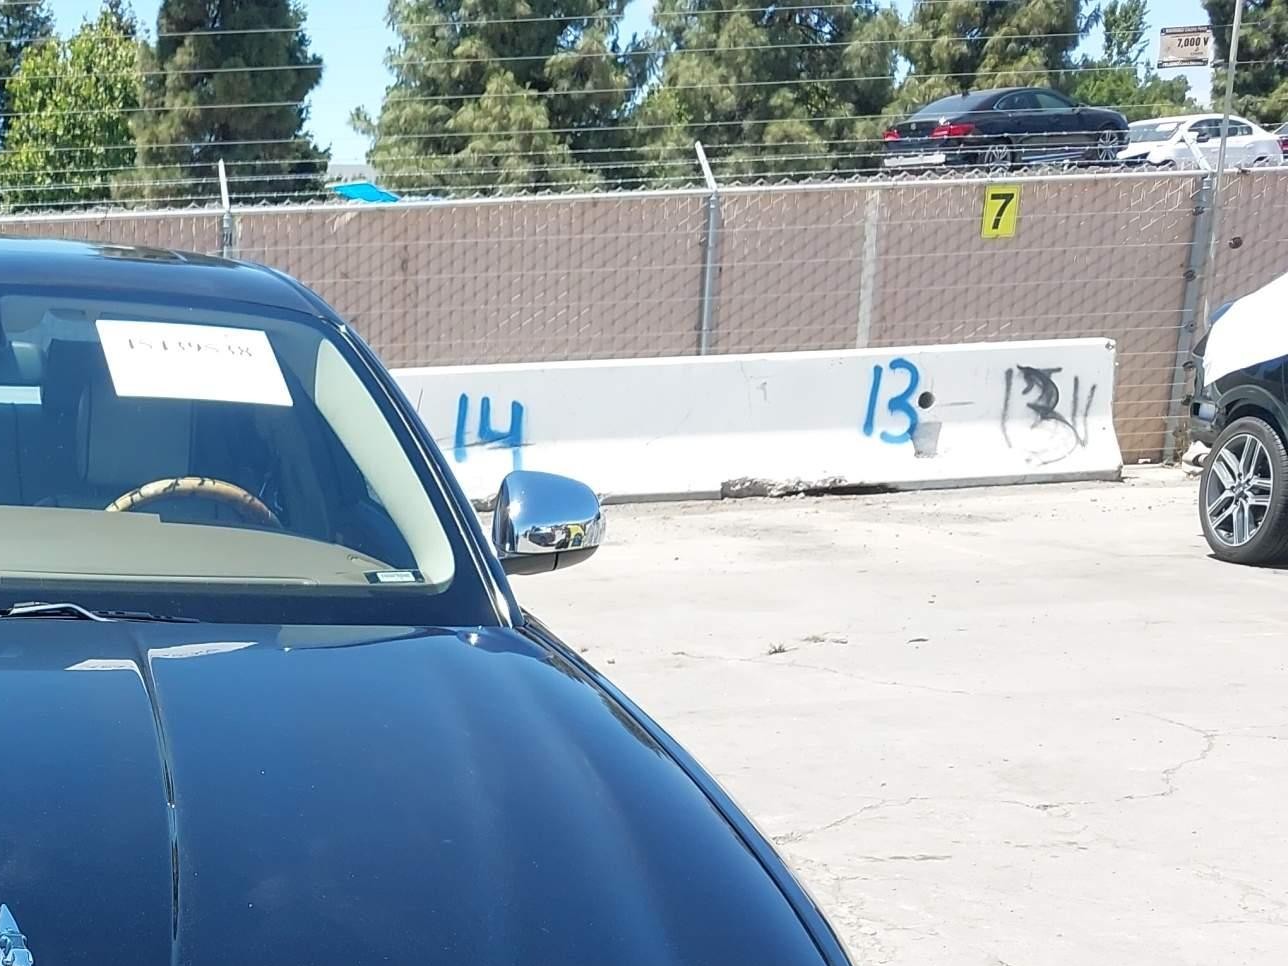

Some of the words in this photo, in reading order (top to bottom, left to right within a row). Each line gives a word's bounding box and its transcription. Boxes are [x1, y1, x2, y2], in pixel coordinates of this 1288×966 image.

[1177, 37, 1201, 48] 7,000
[991, 193, 1014, 230] 7
[863, 358, 920, 444] 13
[455, 392, 524, 471] 14
